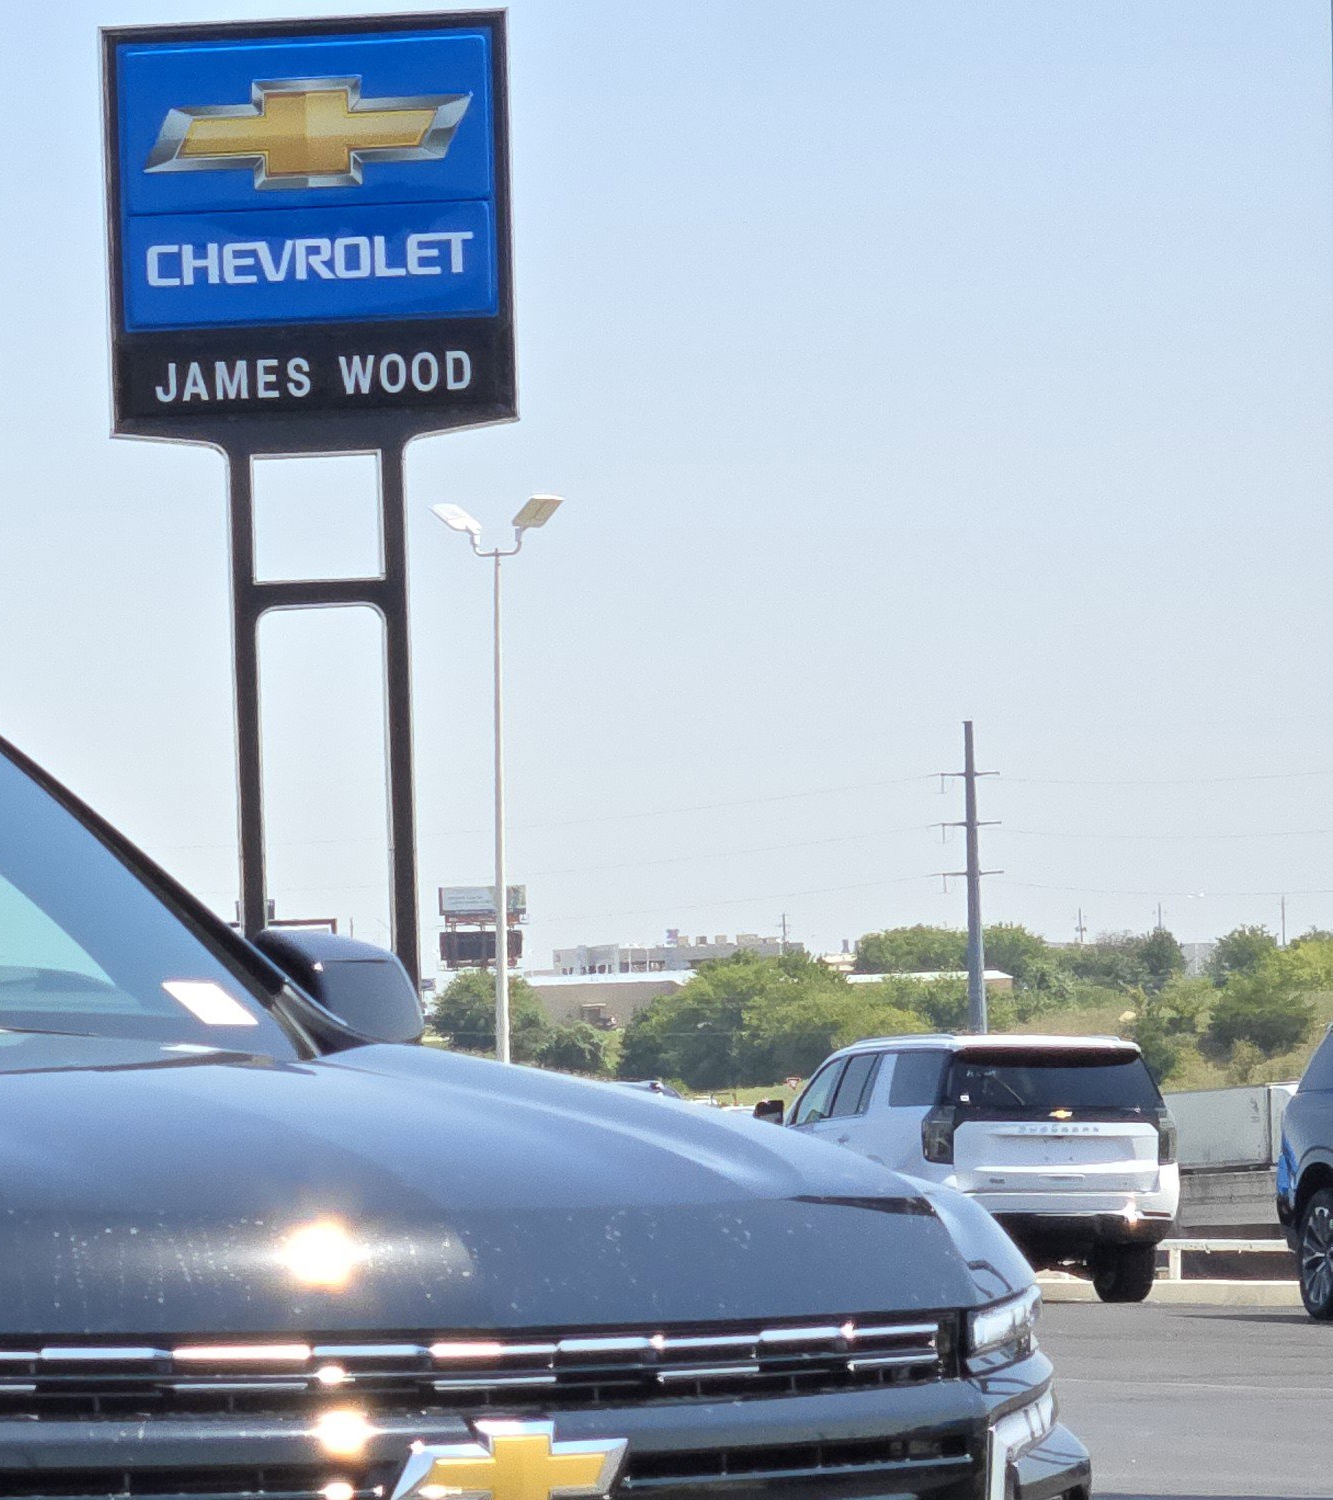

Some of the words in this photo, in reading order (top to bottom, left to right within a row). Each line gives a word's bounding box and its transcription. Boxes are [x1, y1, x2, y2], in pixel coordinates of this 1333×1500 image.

[145, 230, 475, 287] CHEVROLET
[154, 356, 313, 403] JAMES
[338, 349, 473, 396] WOOD
